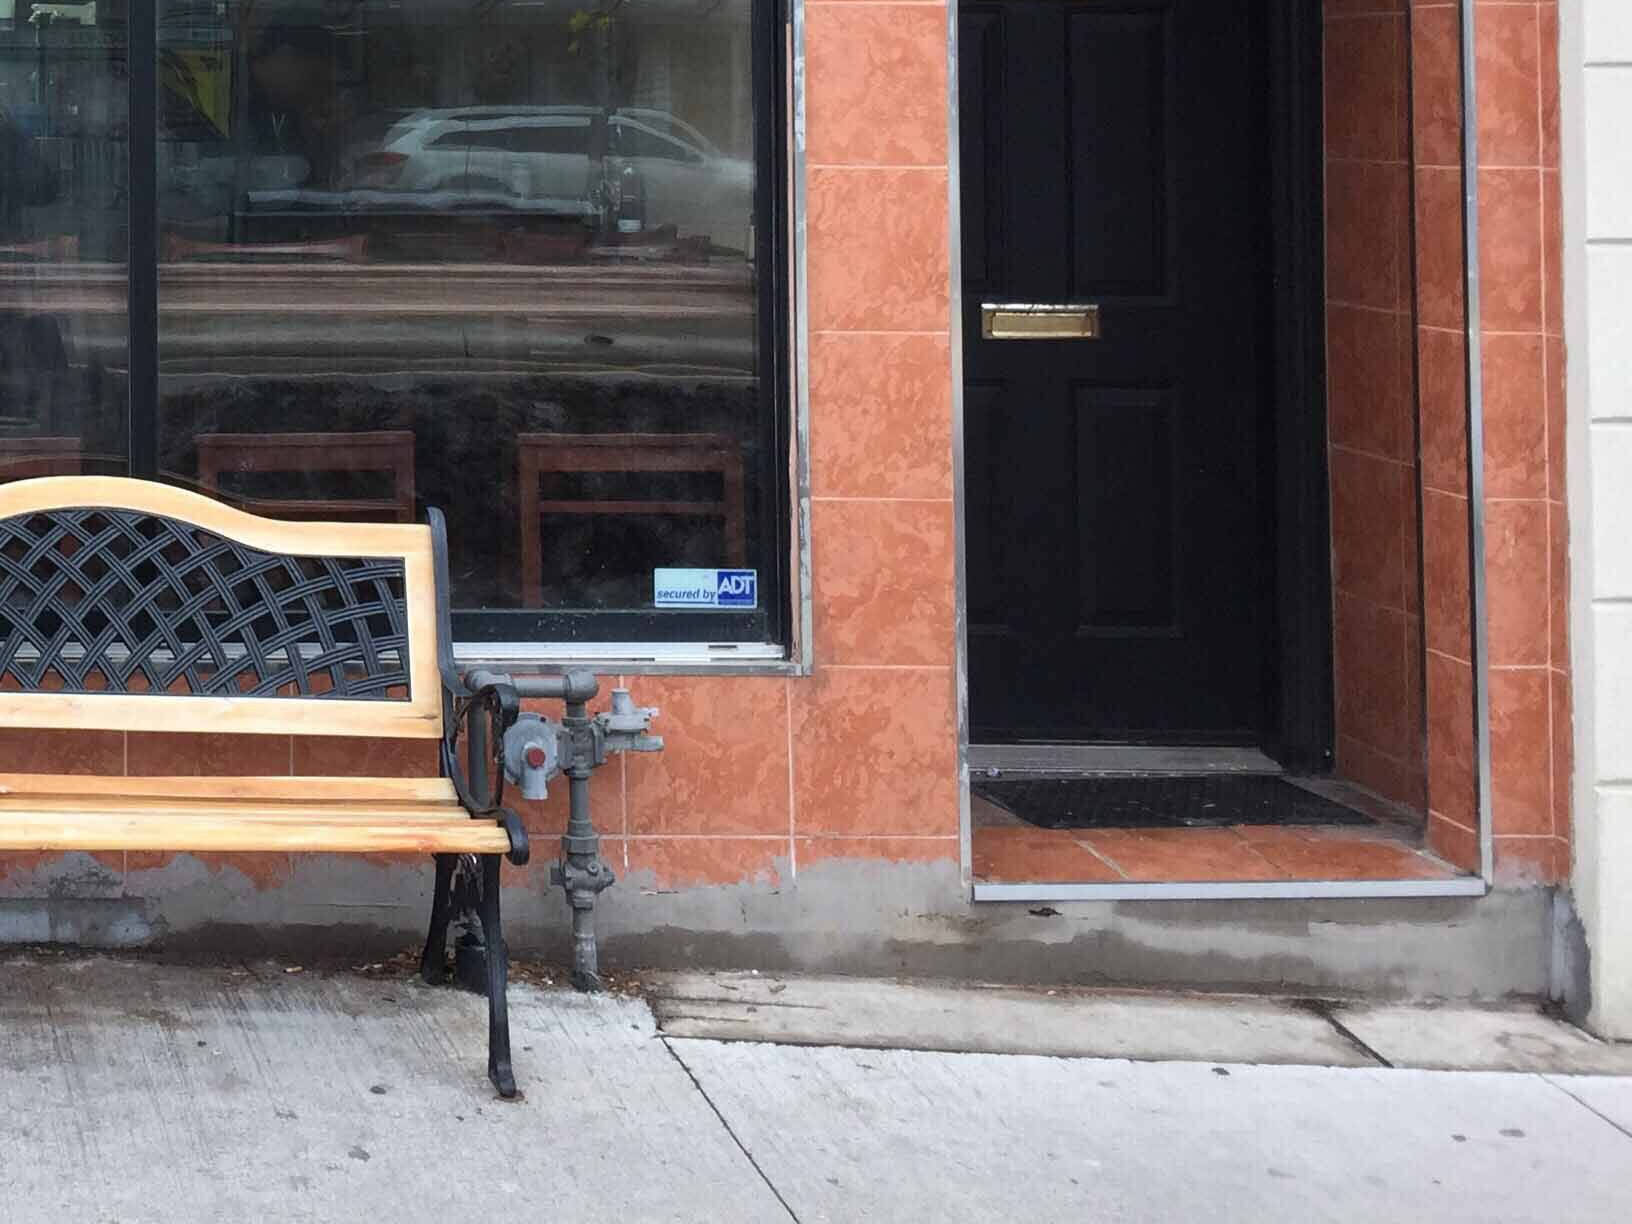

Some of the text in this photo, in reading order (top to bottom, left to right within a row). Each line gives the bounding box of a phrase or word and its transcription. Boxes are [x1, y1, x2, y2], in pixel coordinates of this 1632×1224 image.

[718, 575, 754, 595] ADT
[656, 588, 716, 601] secured by
